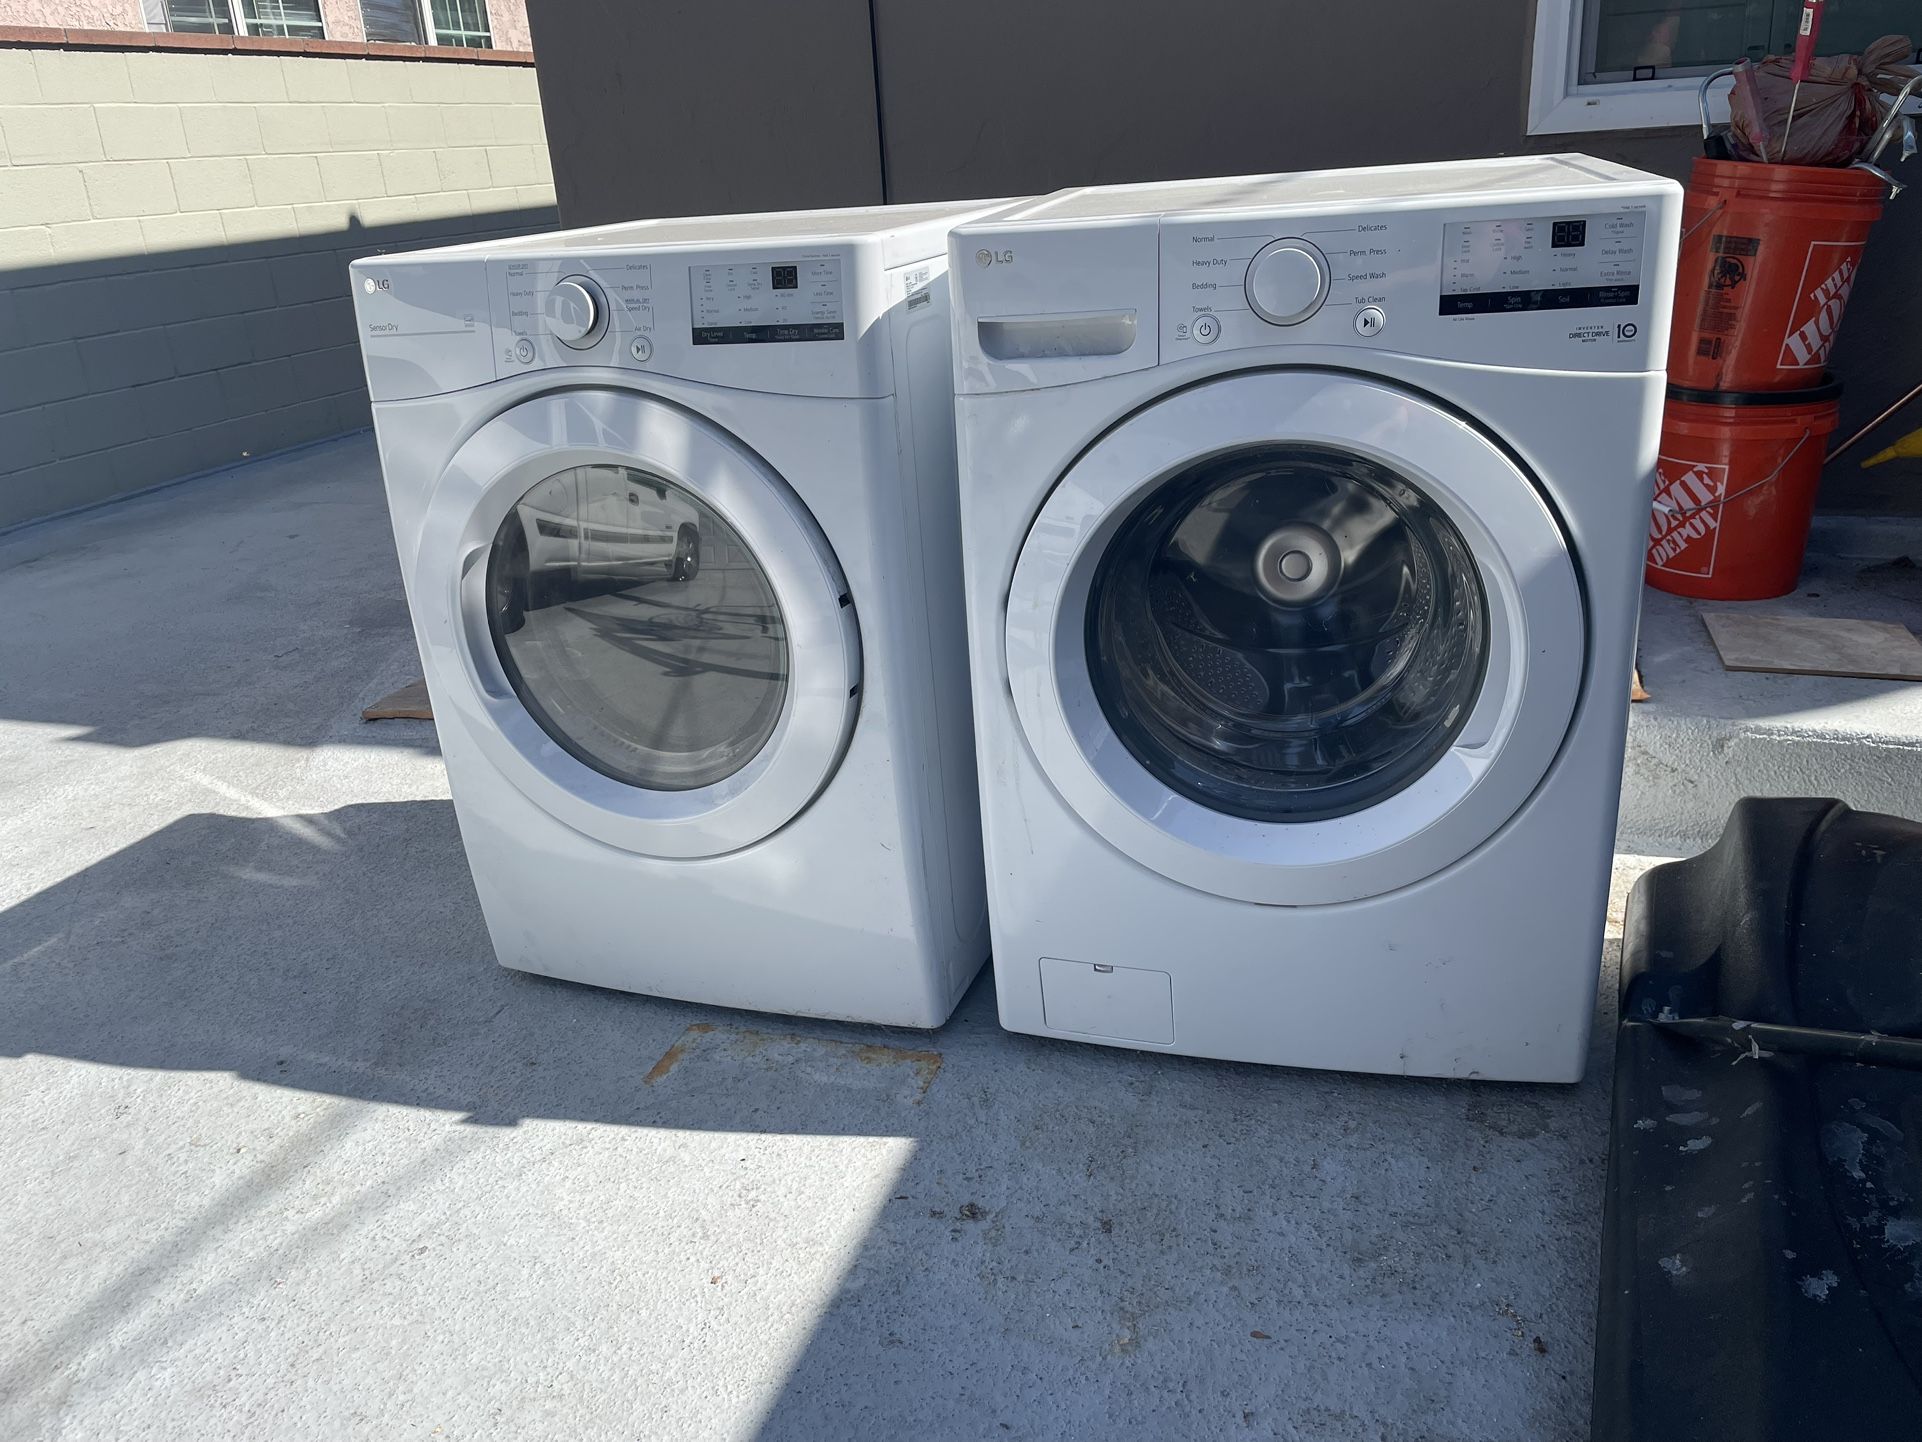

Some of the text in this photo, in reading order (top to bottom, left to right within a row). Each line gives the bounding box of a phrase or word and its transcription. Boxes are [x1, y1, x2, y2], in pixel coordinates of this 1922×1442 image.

[1358, 224, 1388, 232] Delicates
[994, 251, 1014, 264] LG
[1349, 248, 1387, 257] Perm. Press
[1192, 258, 1228, 267] Heavy Duty
[1347, 271, 1387, 282] Speed Wash
[1809, 256, 1853, 306] THE
[376, 279, 390, 291] LG
[1191, 282, 1217, 290] Bedding
[1367, 295, 1386, 303] Clean
[369, 323, 399, 332] Sensor Dry
[1616, 322, 1638, 339] 10
[1568, 330, 1610, 339] DIRECT DRIVE
[1648, 464, 1725, 545] OME
[1651, 507, 1718, 567] DEPOT
